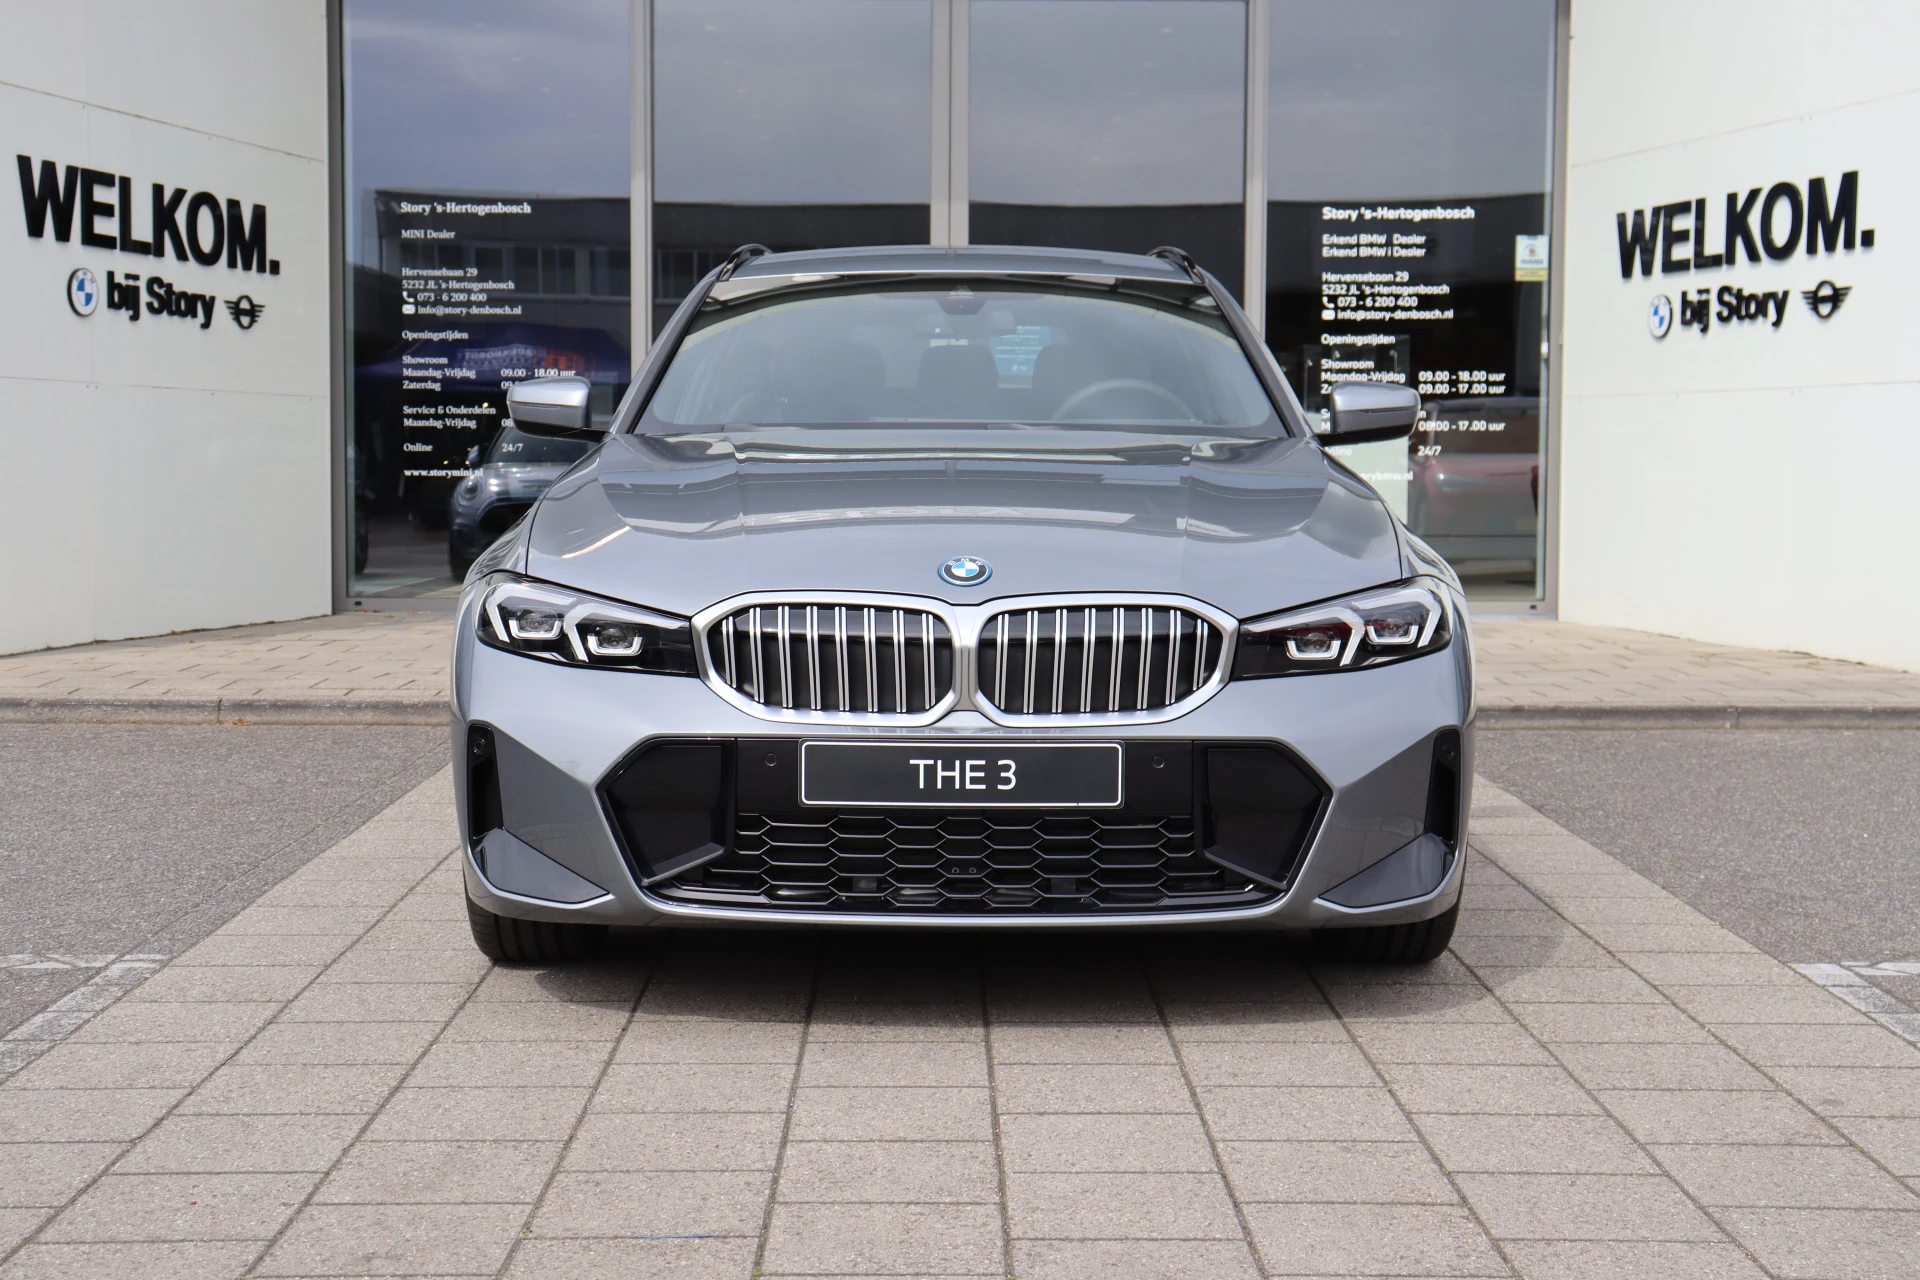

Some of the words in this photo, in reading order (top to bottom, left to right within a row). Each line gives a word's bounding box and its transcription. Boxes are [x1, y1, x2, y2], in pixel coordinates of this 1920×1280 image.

[16, 154, 280, 275] WELKOM.
[400, 202, 431, 215] Story
[434, 202, 531, 216] 's-Hertogenbosch
[1322, 207, 1358, 222] Story
[1360, 206, 1475, 222] 's-Hertogenbosch
[1616, 170, 1874, 278] WELKOM.
[401, 230, 424, 239] MINI
[427, 230, 455, 239] Dealer
[1322, 234, 1357, 245] Erkend
[1359, 234, 1386, 244] BMW
[1393, 234, 1426, 245] Dealer
[1322, 247, 1357, 257] Erkend
[1359, 247, 1387, 257] BMW
[1393, 247, 1426, 257] Dealer
[402, 268, 464, 277] Hervensebaan
[466, 268, 478, 277] 29
[1322, 273, 1393, 282] Hervensebaan
[1395, 271, 1409, 282] 29
[402, 280, 425, 289] 5232
[426, 280, 437, 290] JL
[439, 280, 515, 291] 's-Hertogenbosch
[1322, 284, 1347, 295] 5232
[1348, 285, 1360, 295] JL
[1362, 284, 1449, 296] 's-Hertogenbosch
[107, 270, 140, 322] bij
[146, 276, 216, 329] Story
[418, 293, 435, 302] 073
[442, 293, 448, 302] 6
[451, 293, 468, 302] 200
[470, 293, 487, 302] 400
[1337, 297, 1357, 307] 073
[1366, 297, 1373, 307] 6
[1374, 297, 1395, 307] 200
[1397, 297, 1418, 307] 400
[418, 305, 522, 316] info@story-denbosch.nl
[1338, 309, 1453, 322] info@story-denbosch.nl
[1680, 288, 1710, 334] bij
[1716, 286, 1790, 328] Story
[402, 330, 468, 341] Openingstijden
[1321, 334, 1395, 346] Openingstijden
[402, 355, 448, 365] Showroom
[1321, 359, 1374, 370] Showroom
[403, 368, 476, 379] Maandag-Vrijdag
[501, 369, 526, 377] 09.00
[534, 369, 558, 377] 18.00
[1321, 371, 1406, 383] Maandag-Vrijdag
[1418, 371, 1449, 382] 09.00
[1458, 371, 1487, 382] 18.00
[1488, 373, 1506, 382] uur
[403, 381, 441, 391] Zaterdag
[1418, 384, 1449, 394] 09.00
[1488, 385, 1506, 394] uur
[403, 406, 436, 415] Service
[437, 406, 444, 415] &
[446, 406, 496, 415] Onderdelen
[404, 418, 476, 429] Maandag-Vrijdag
[1418, 421, 1449, 431] 08.00
[1488, 422, 1506, 431] uur
[404, 443, 433, 452] Online
[502, 443, 523, 452] 24/7
[1418, 446, 1442, 457] 24/7
[404, 468, 483, 479] www.storymini.nl
[1360, 472, 1413, 482] orybmw.nl
[910, 760, 986, 790] THE
[997, 759, 1016, 790] 3
